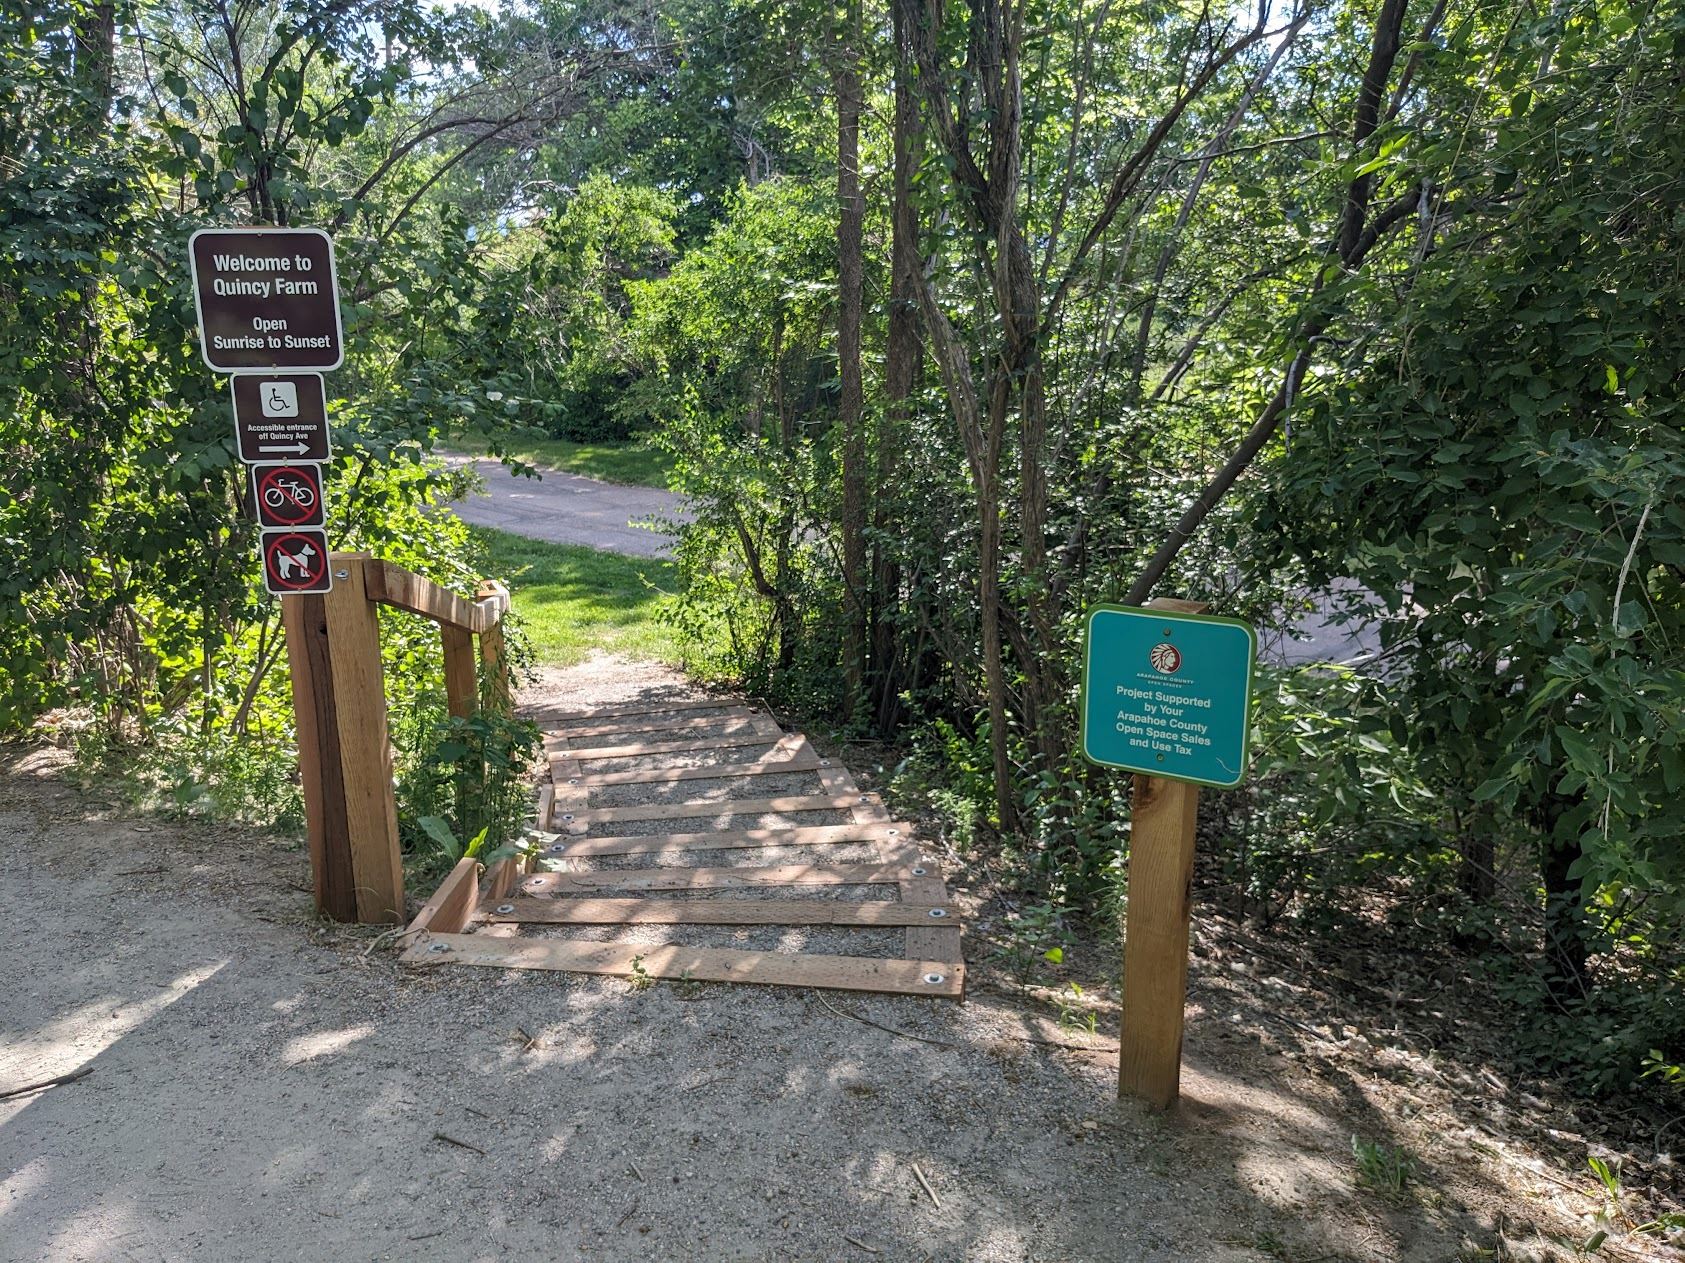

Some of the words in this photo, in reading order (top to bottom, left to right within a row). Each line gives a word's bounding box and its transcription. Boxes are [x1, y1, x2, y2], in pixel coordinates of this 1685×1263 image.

[213, 254, 291, 272] Welcome
[295, 255, 312, 271] to
[213, 278, 270, 298] Quincy
[275, 278, 317, 294] Farm
[253, 317, 287, 333] Open
[214, 336, 264, 349] Sunrise
[268, 336, 281, 348] to
[285, 335, 330, 348] Sunset
[1116, 685, 1153, 700] Project
[1155, 691, 1211, 708] Supported
[1144, 703, 1157, 713] by
[1160, 705, 1183, 716] Your
[1117, 711, 1167, 727] Arapahoe
[1169, 718, 1208, 734] County
[1116, 723, 1144, 735] Open
[1146, 727, 1178, 741] Space
[1181, 733, 1211, 746] Sales
[1129, 737, 1149, 748] and
[1152, 740, 1171, 752] Use
[1174, 745, 1192, 755] Tax
